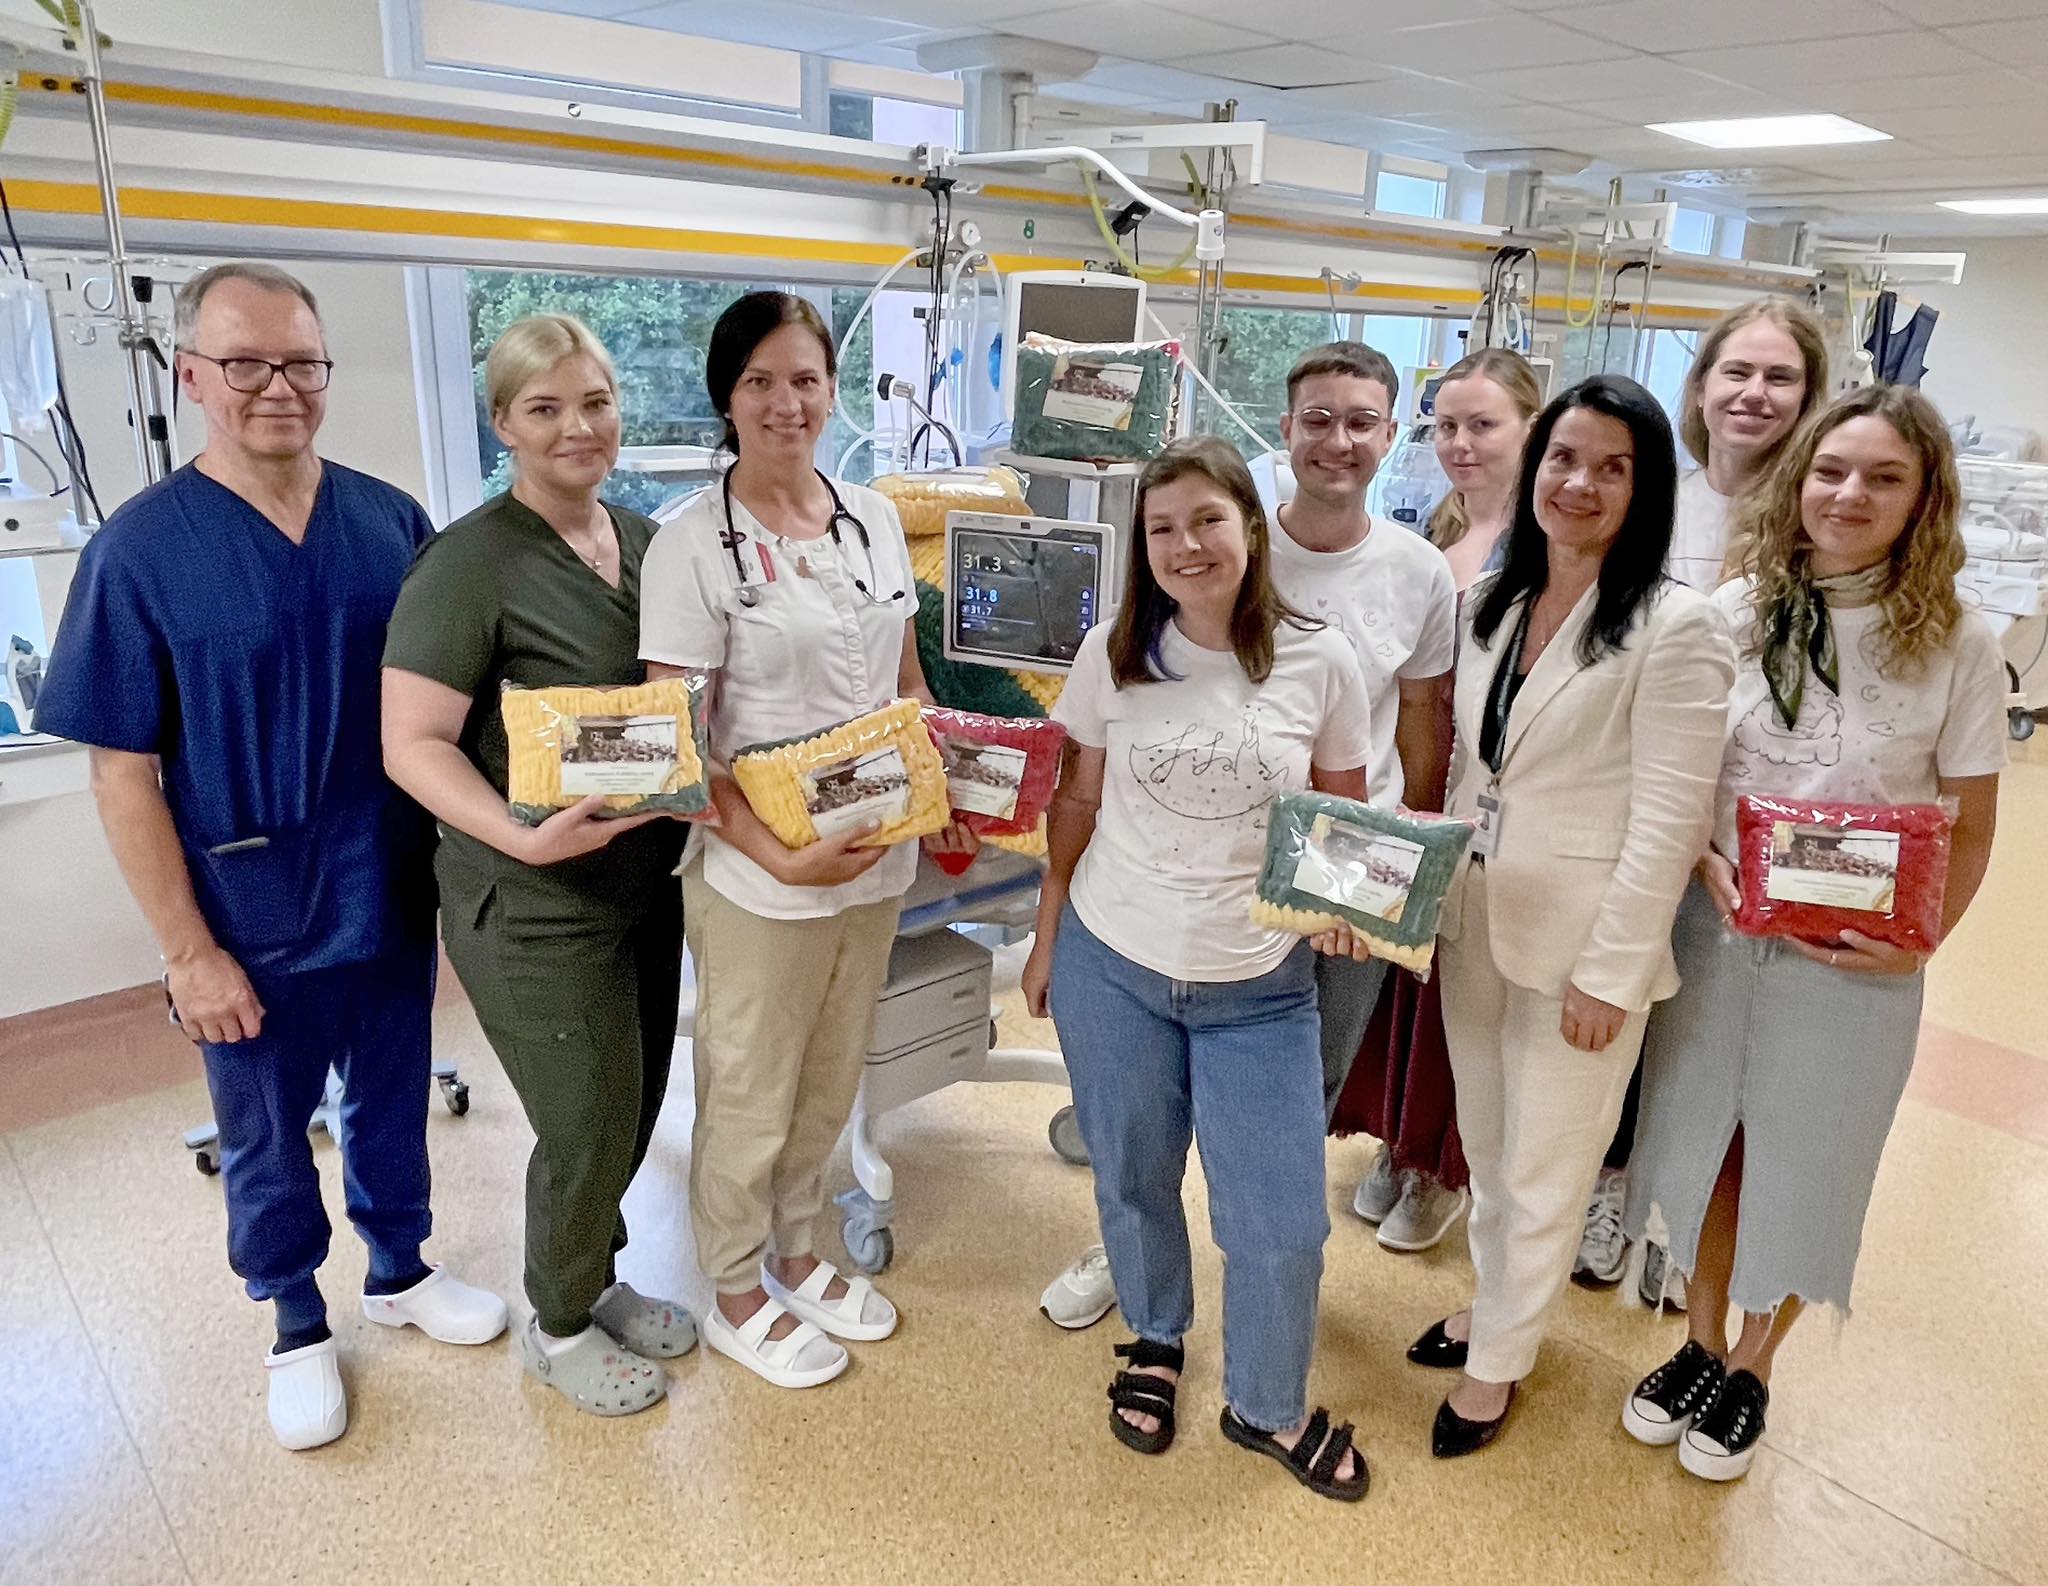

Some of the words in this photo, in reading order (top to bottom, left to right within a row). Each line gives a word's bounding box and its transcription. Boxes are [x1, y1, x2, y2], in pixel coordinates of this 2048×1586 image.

[963, 553, 1002, 572] 31.3
[966, 586, 998, 603] 31.8
[970, 604, 993, 616] 31.7
